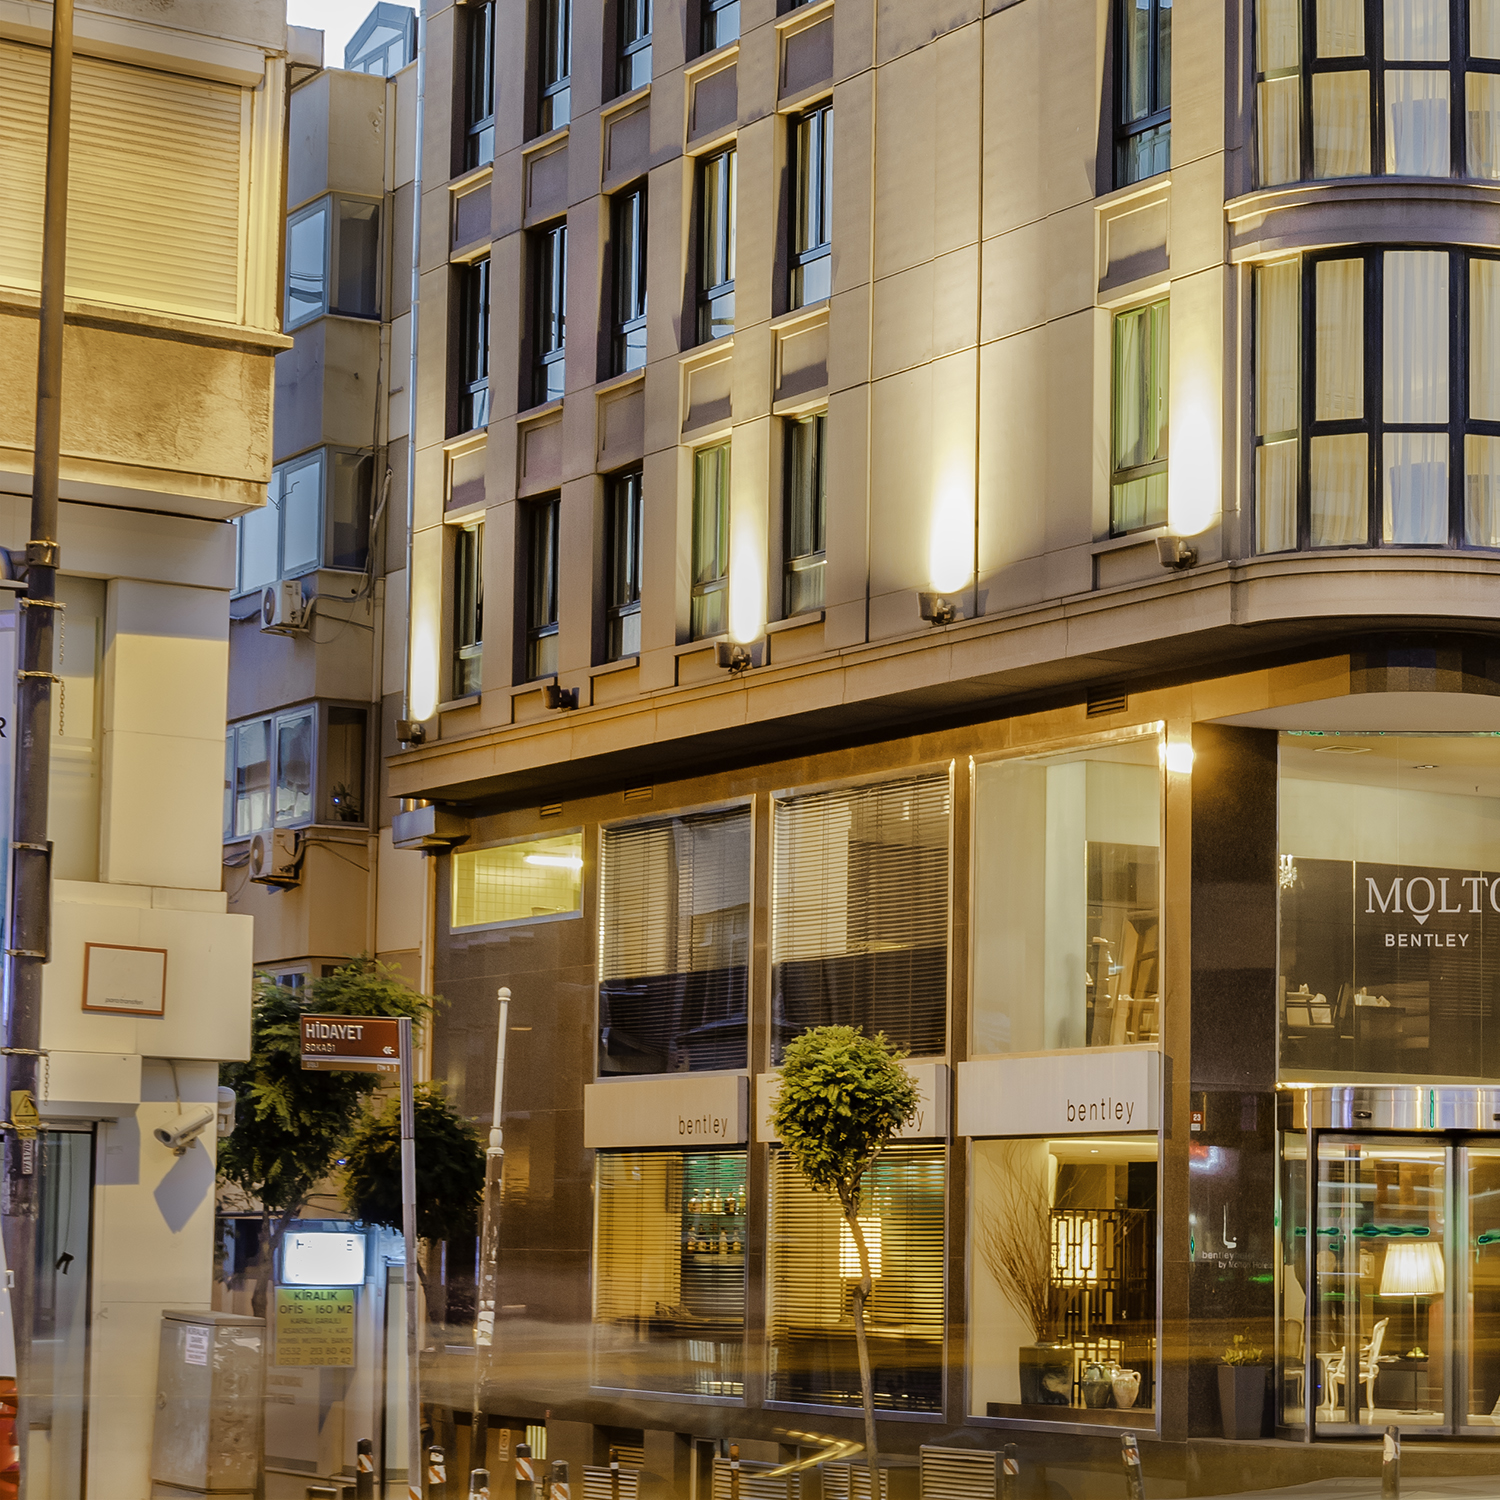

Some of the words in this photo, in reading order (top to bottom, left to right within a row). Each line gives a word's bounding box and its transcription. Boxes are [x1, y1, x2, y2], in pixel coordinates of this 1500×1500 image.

[1384, 933, 1470, 948] BENTLEY
[305, 1021, 364, 1041] HİDAYET
[304, 1042, 336, 1053] SOKAĞI
[1066, 1097, 1135, 1125] bentley
[1193, 1113, 1202, 1122] 23
[678, 1114, 729, 1138] bentley
[294, 1289, 339, 1301] KİRALIK
[279, 1303, 304, 1315] OFİS
[315, 1304, 334, 1314] 160
[337, 1304, 353, 1315] M2
